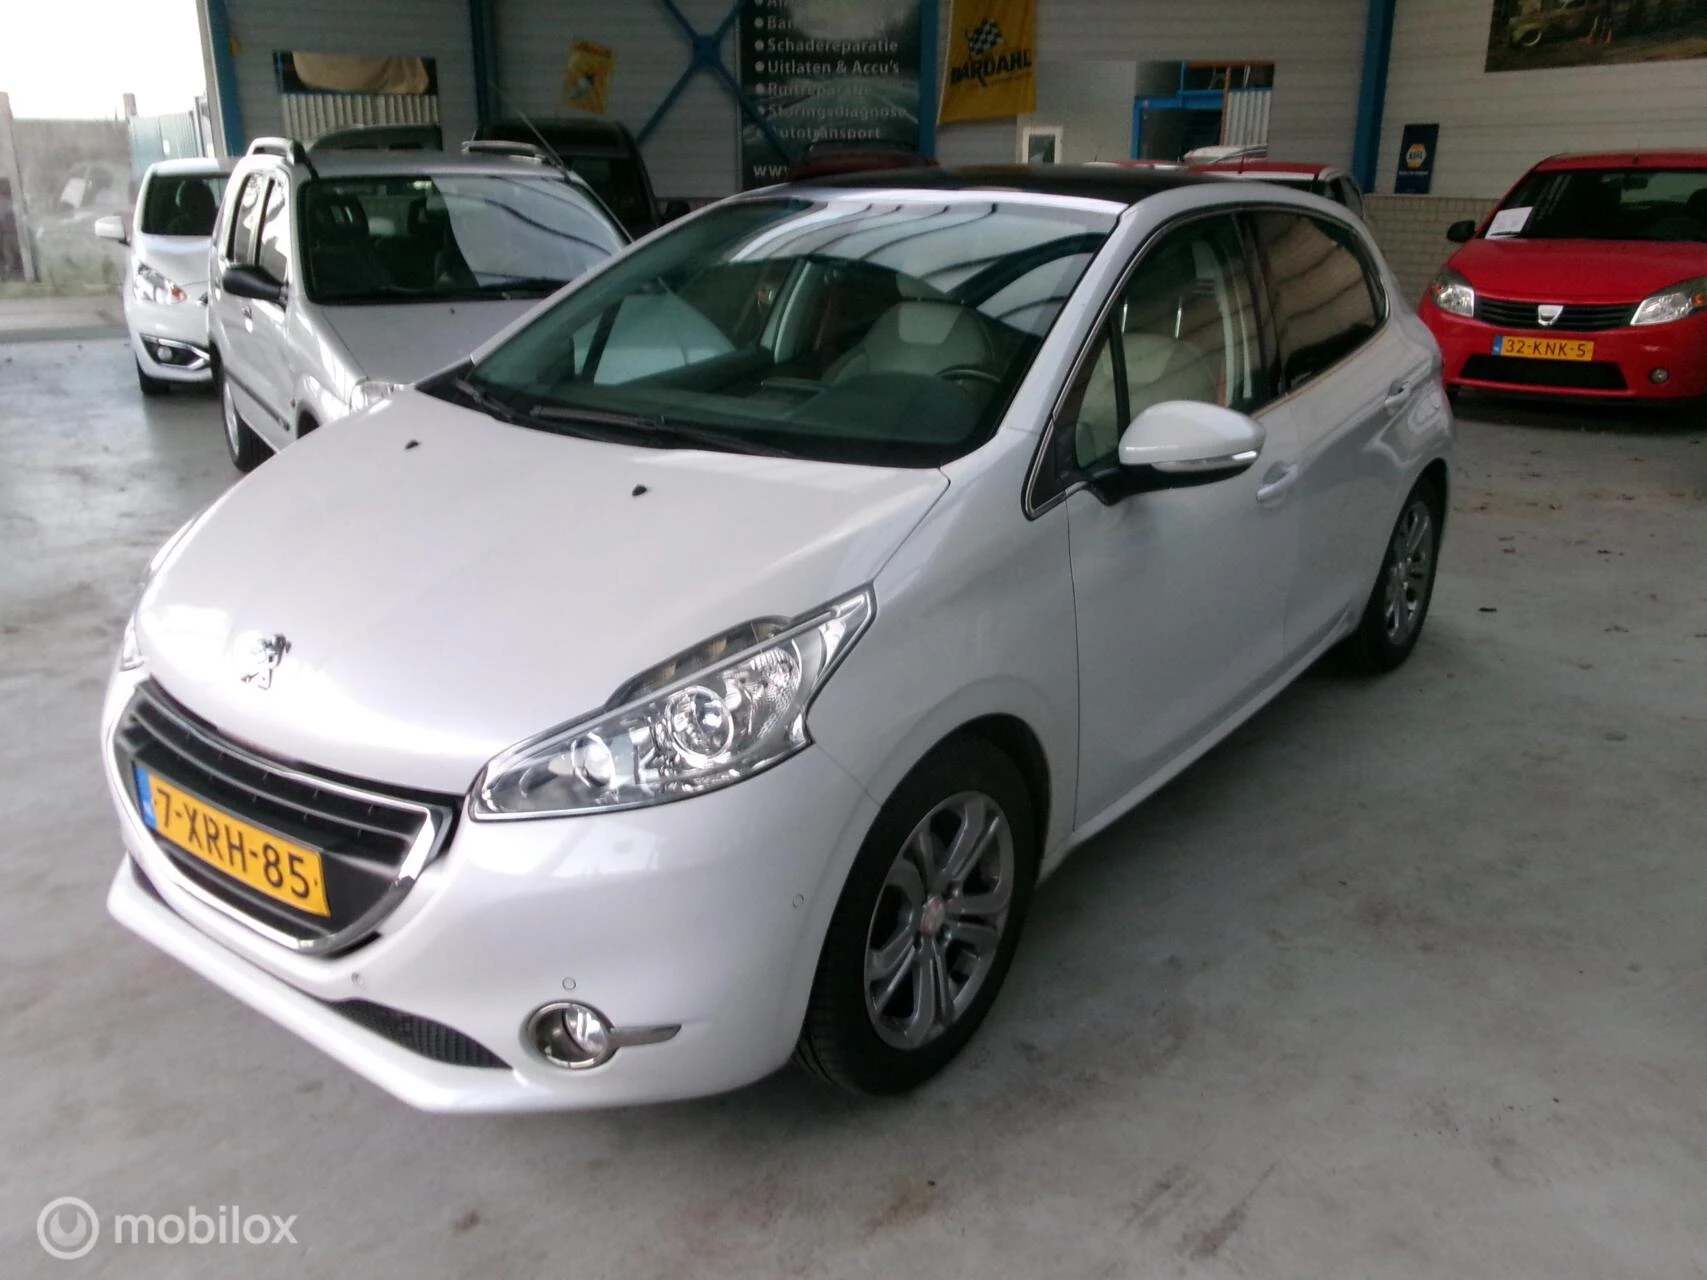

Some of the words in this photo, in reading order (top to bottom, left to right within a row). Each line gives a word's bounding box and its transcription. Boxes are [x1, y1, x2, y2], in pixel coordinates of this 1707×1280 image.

[767, 37, 899, 55] Schadereparatie
[767, 60, 831, 74] Uitlaten
[835, 60, 847, 74] &
[852, 60, 900, 74] Accu's
[1506, 338, 1586, 358] 32-KNK-5
[157, 786, 310, 899] 7-XRH-85
